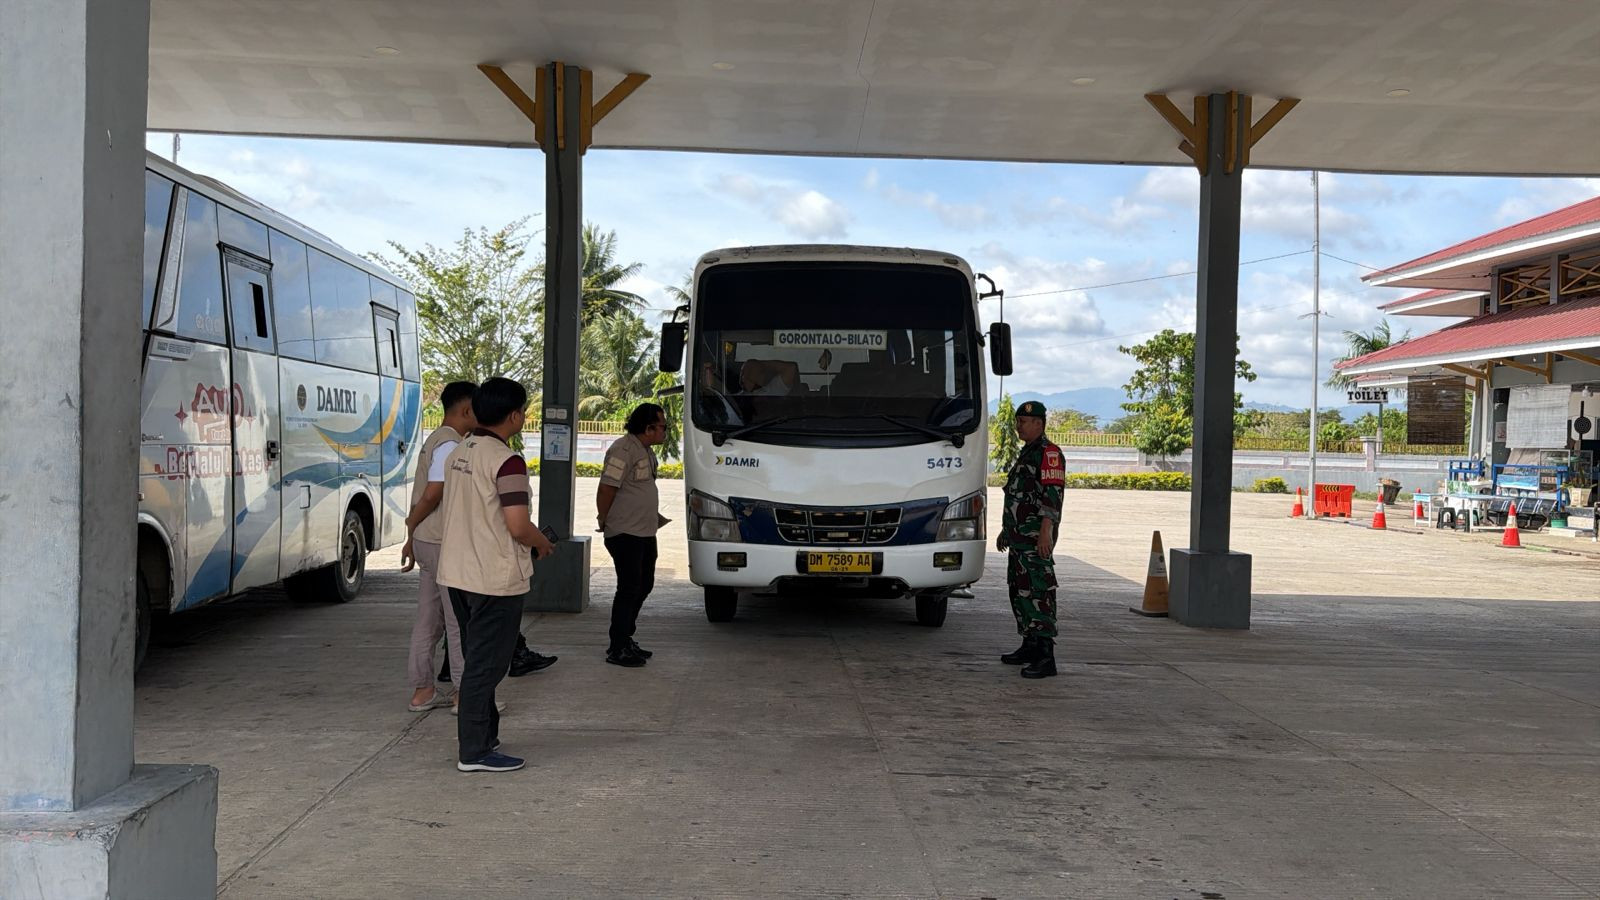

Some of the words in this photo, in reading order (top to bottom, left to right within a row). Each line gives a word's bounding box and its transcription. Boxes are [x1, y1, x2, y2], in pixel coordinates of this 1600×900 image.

[779, 332, 883, 346] GORONTALO-BILATO
[316, 385, 357, 414] DAMRI
[1347, 391, 1388, 401] TOILET
[725, 456, 760, 468] DAMRI
[927, 456, 963, 470] 5473
[809, 554, 823, 566] DM
[827, 554, 853, 566] 7589
[857, 555, 870, 567] AA
